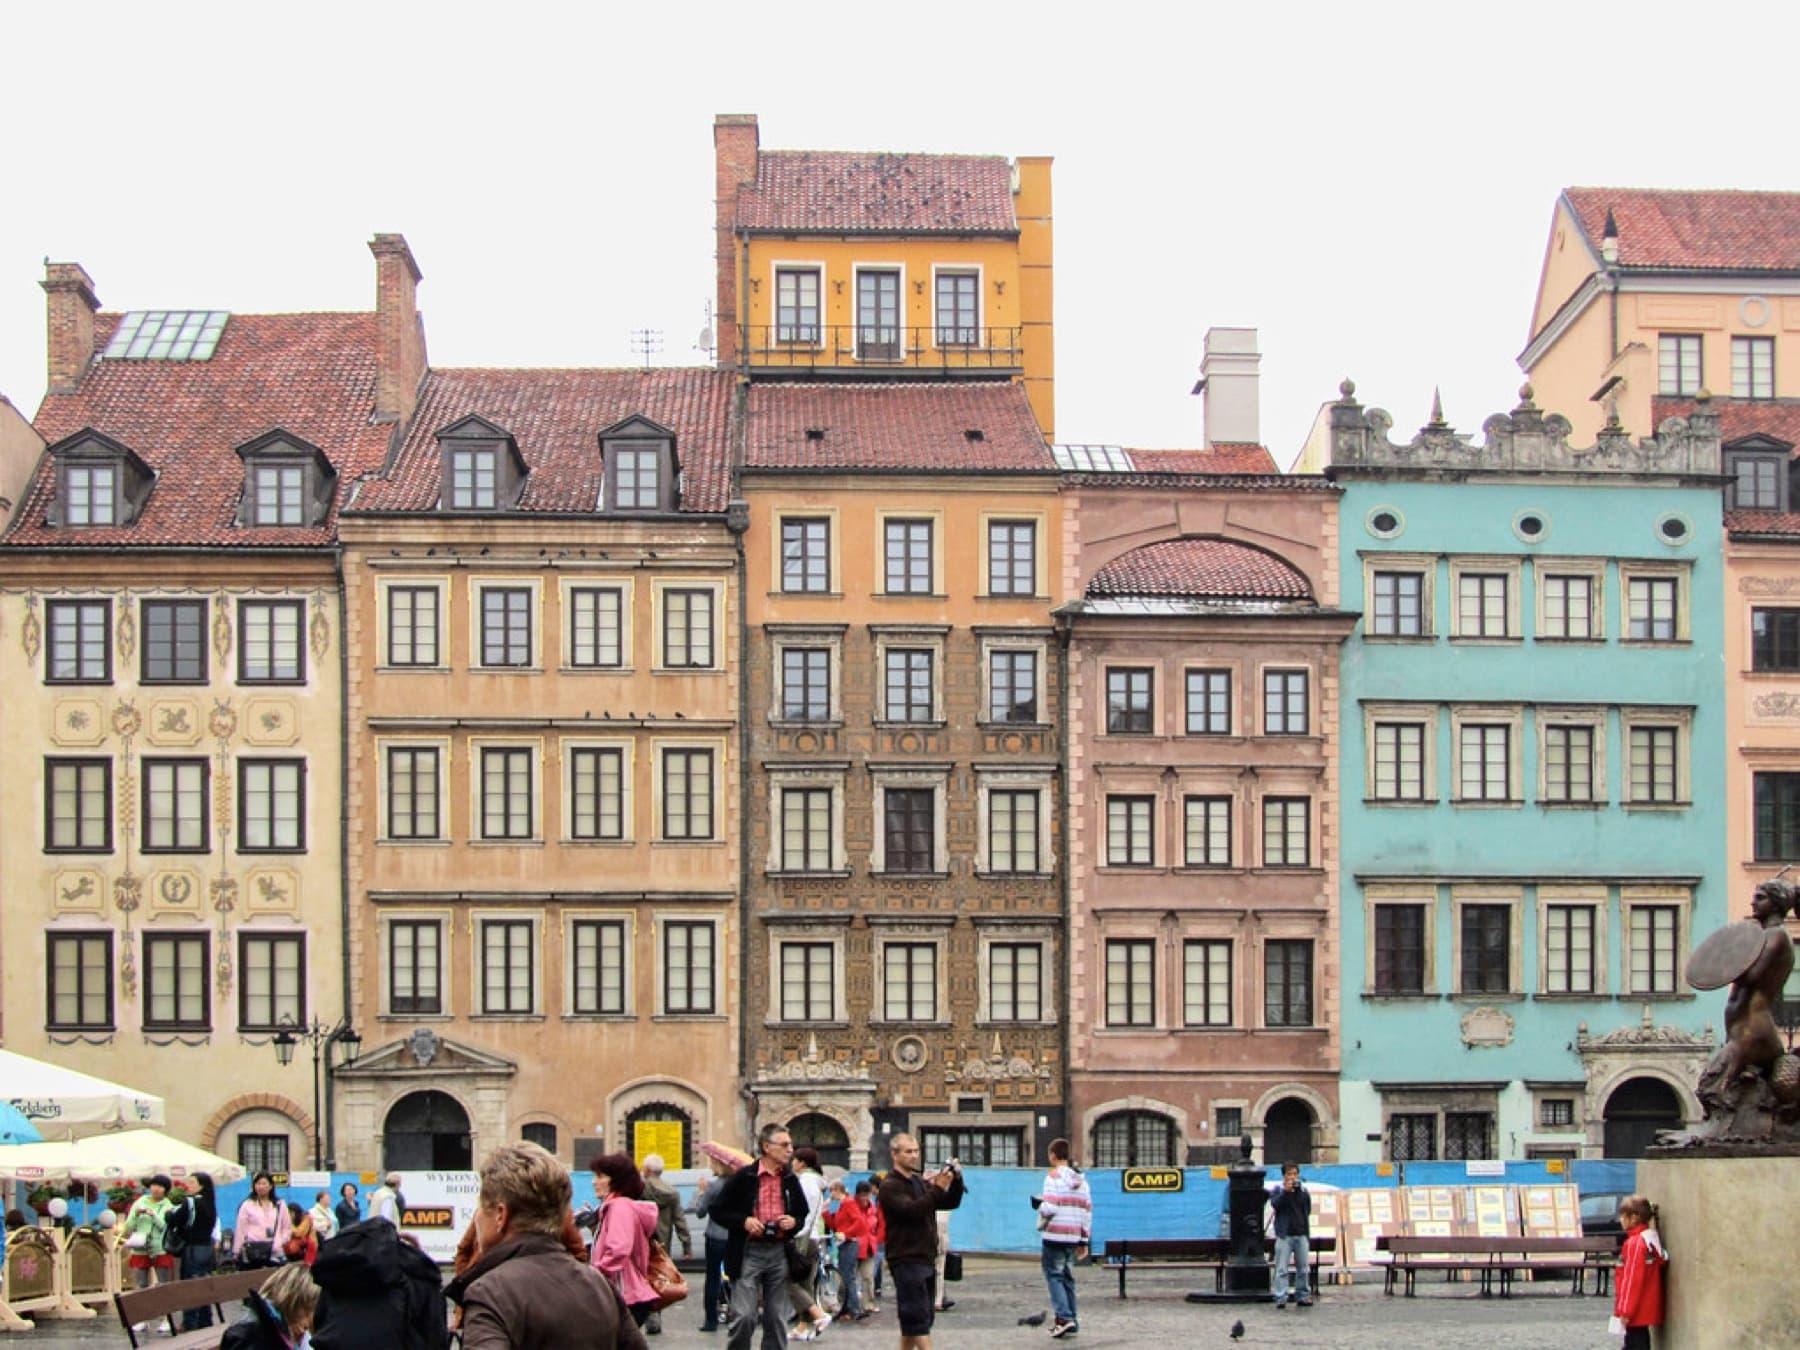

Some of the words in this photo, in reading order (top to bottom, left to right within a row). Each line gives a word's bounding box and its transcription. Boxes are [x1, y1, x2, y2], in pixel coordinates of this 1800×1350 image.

[425, 1173, 480, 1181] WYKONA
[1129, 1174, 1177, 1185] AMP
[402, 1211, 450, 1224] AMP
